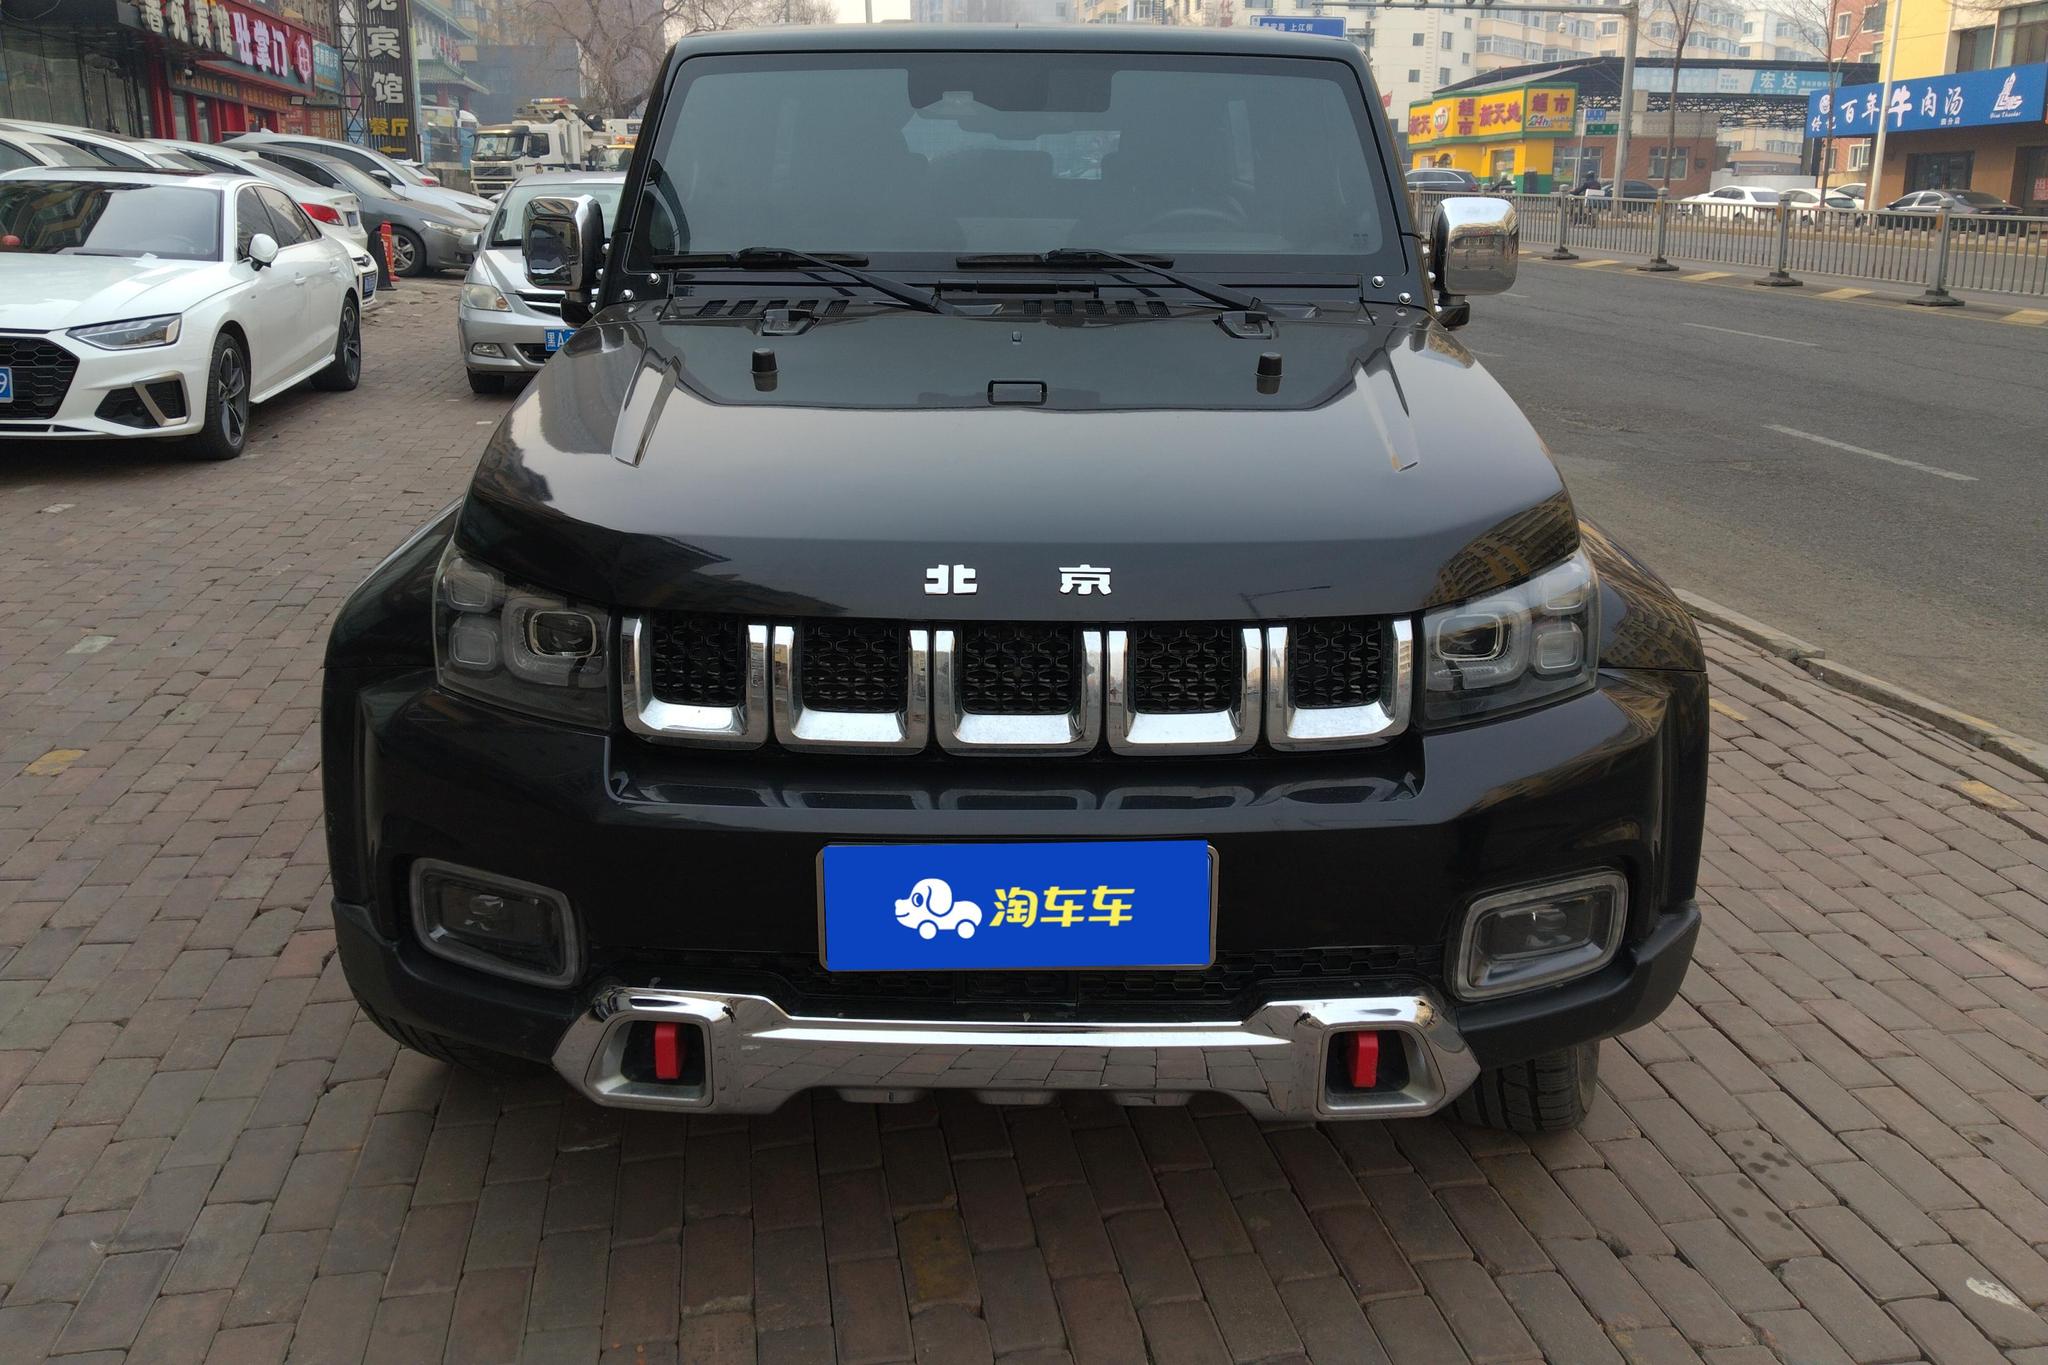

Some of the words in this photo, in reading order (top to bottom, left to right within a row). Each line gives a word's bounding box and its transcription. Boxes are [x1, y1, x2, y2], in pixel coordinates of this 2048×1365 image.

[1759, 71, 1798, 89] 宏达
[1841, 84, 1964, 128] 百年牛肉汤
[369, 117, 409, 137] 餐厅
[924, 564, 1112, 595] 北京
